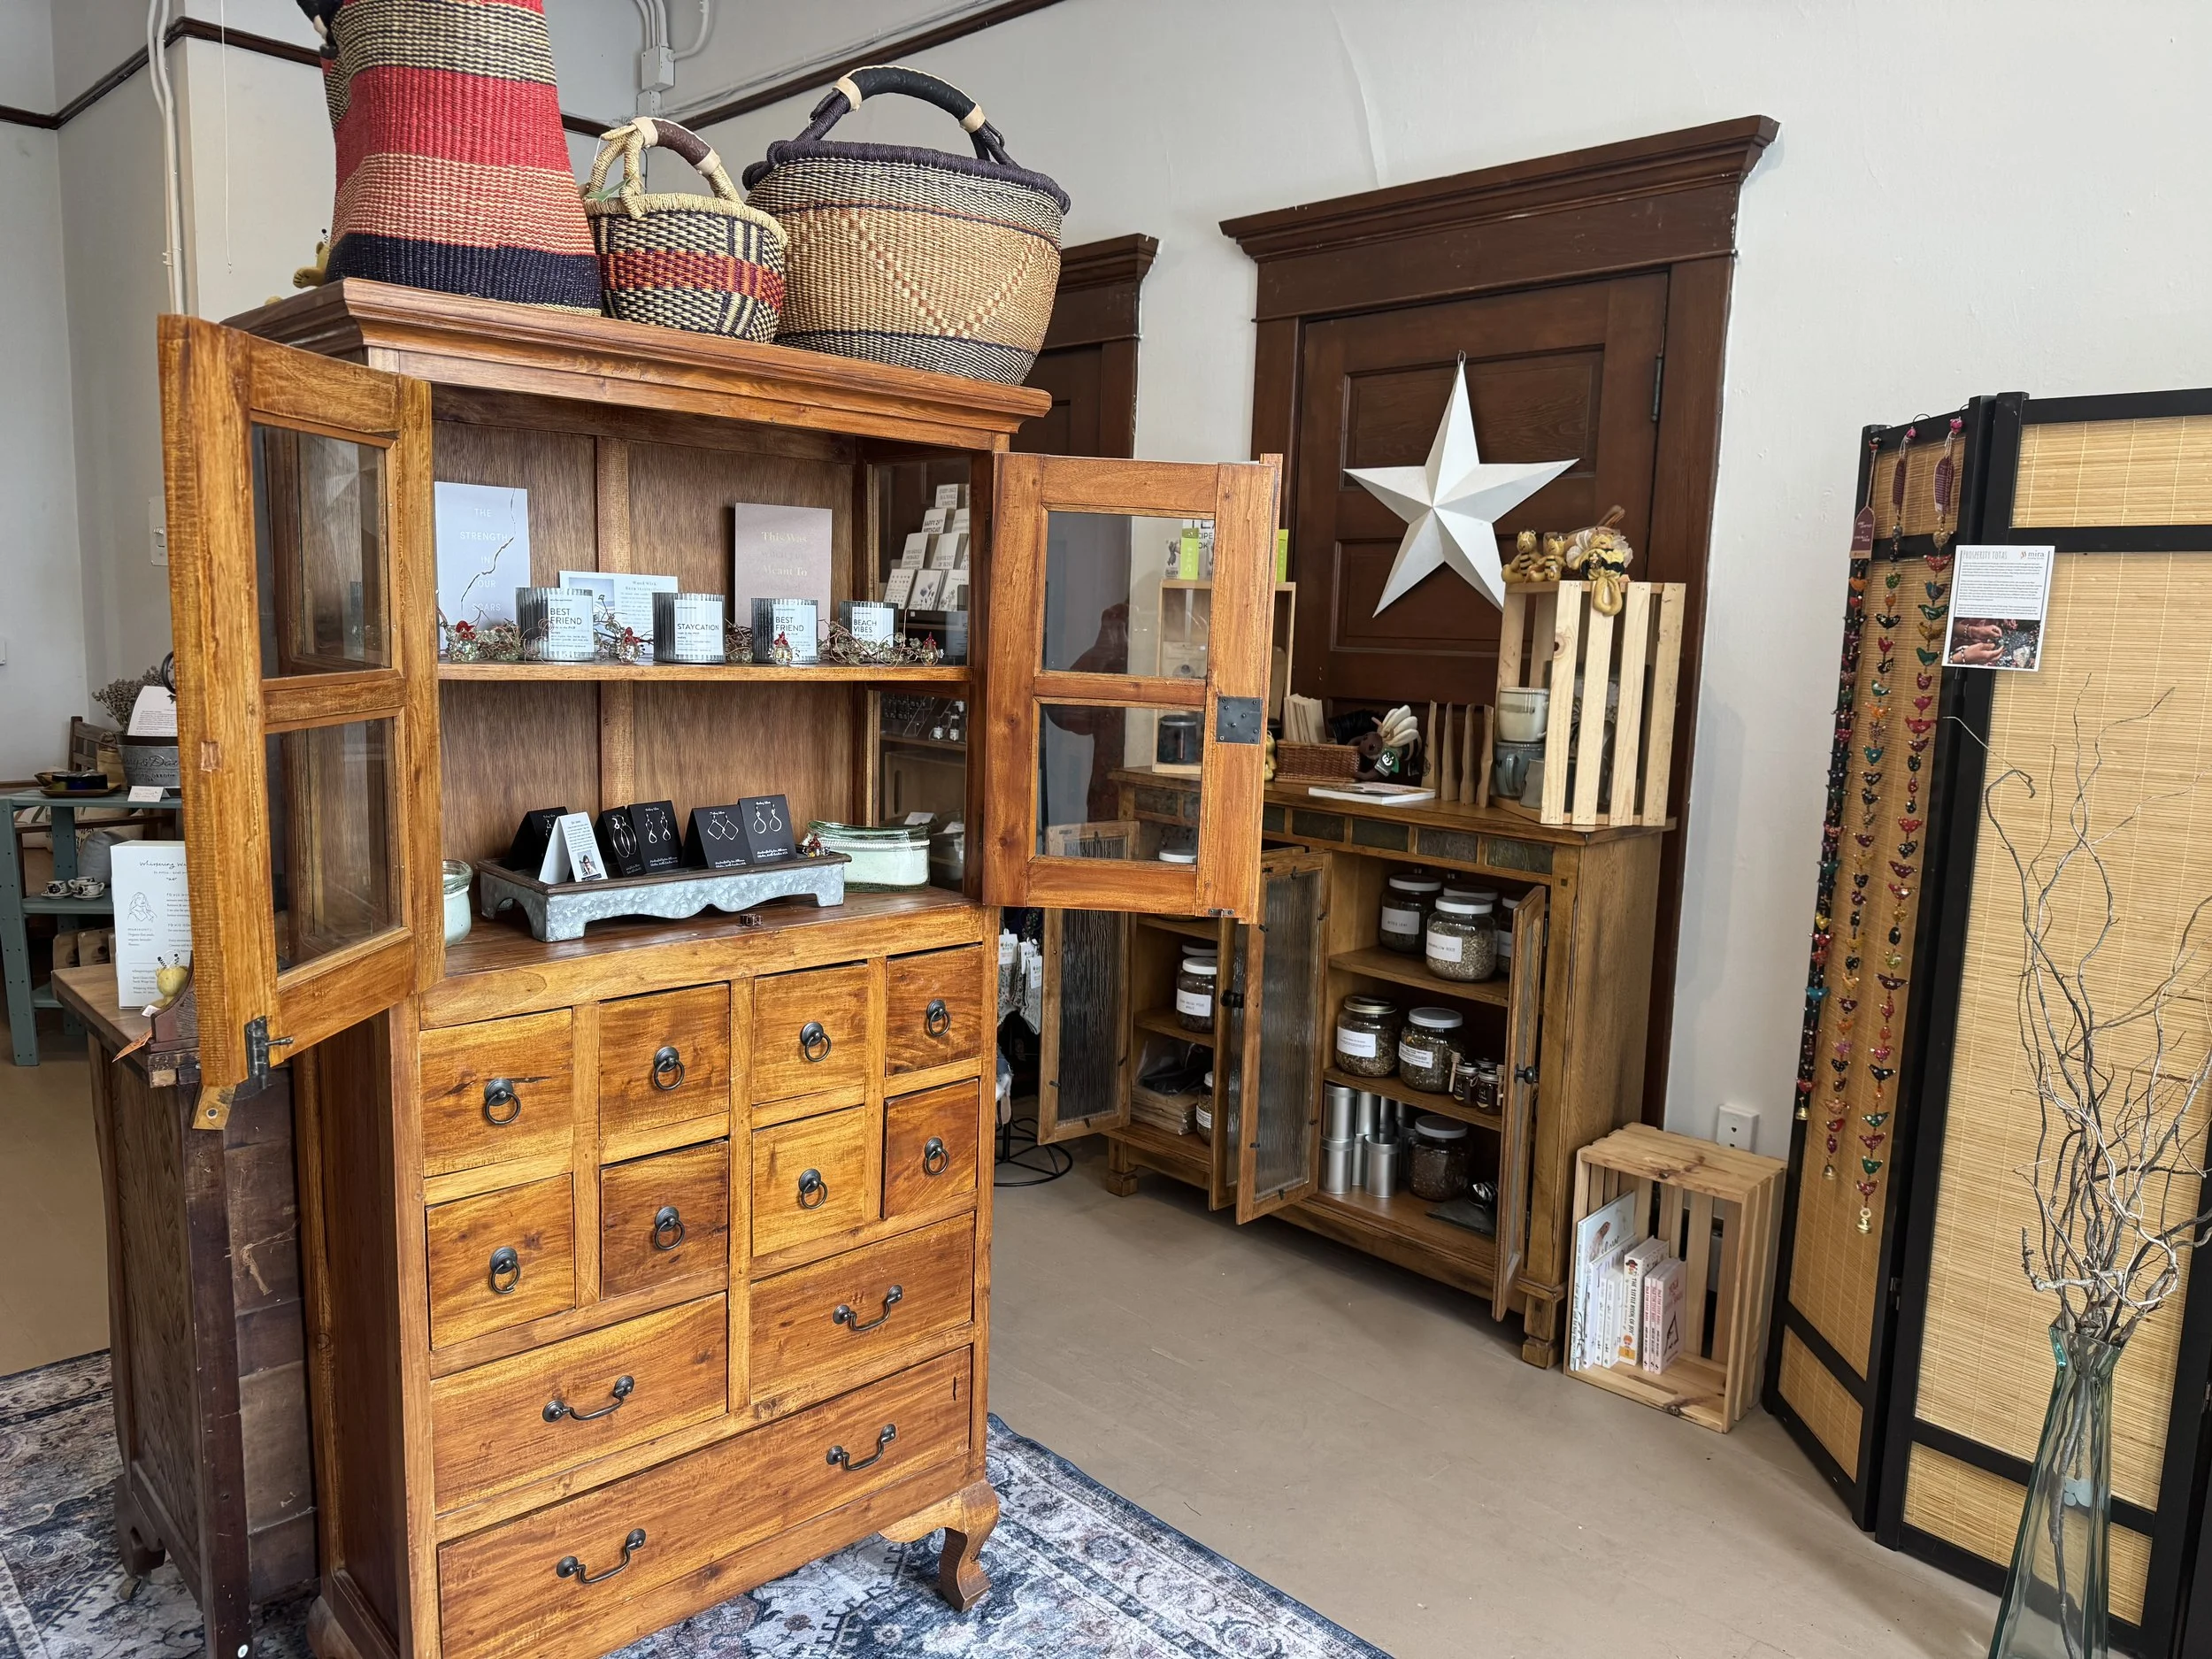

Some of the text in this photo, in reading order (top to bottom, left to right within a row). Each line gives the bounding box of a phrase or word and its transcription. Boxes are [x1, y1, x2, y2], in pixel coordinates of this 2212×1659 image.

[473, 508, 492, 518] THE
[459, 531, 508, 542] STRENGTH
[761, 531, 808, 543] This Was
[1962, 549, 1991, 560] PROSPERITY
[480, 556, 490, 565] IN
[764, 565, 808, 577] Meant To
[477, 580, 496, 589] OUR
[472, 603, 502, 612] SCARS
[549, 607, 571, 616] BEST
[549, 616, 582, 626] FRIEND
